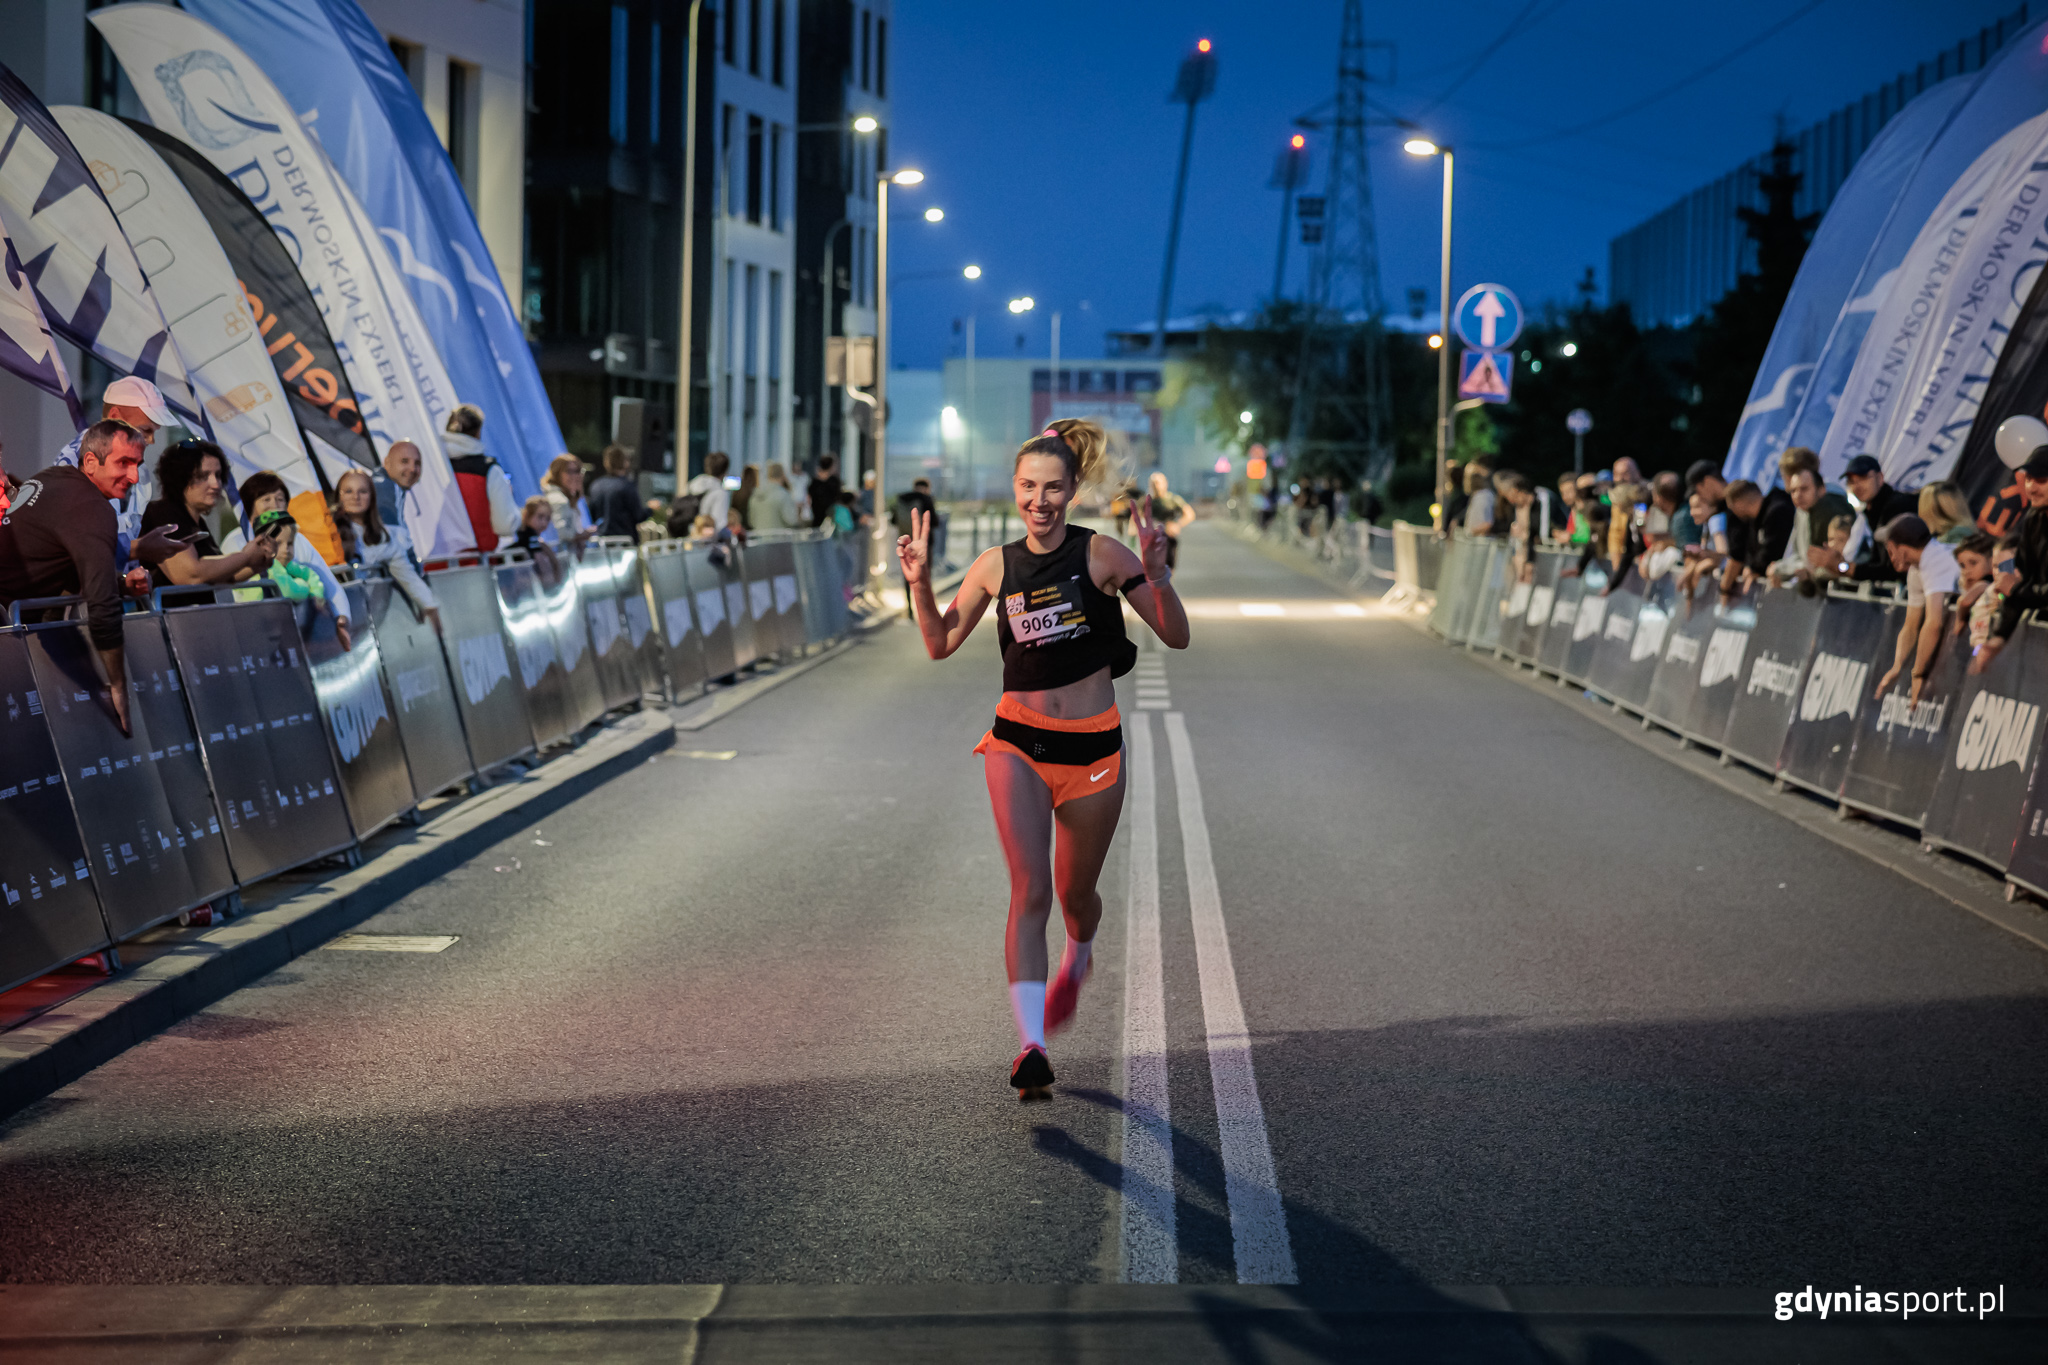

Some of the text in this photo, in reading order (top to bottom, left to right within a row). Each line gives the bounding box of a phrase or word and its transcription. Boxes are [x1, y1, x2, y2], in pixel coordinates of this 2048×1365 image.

[1882, 227, 1967, 378] DERMOSKIN
[1949, 184, 2041, 342] DERMOSKIN
[1021, 612, 1061, 635] 9062
[1955, 689, 2041, 774] GDYNIA
